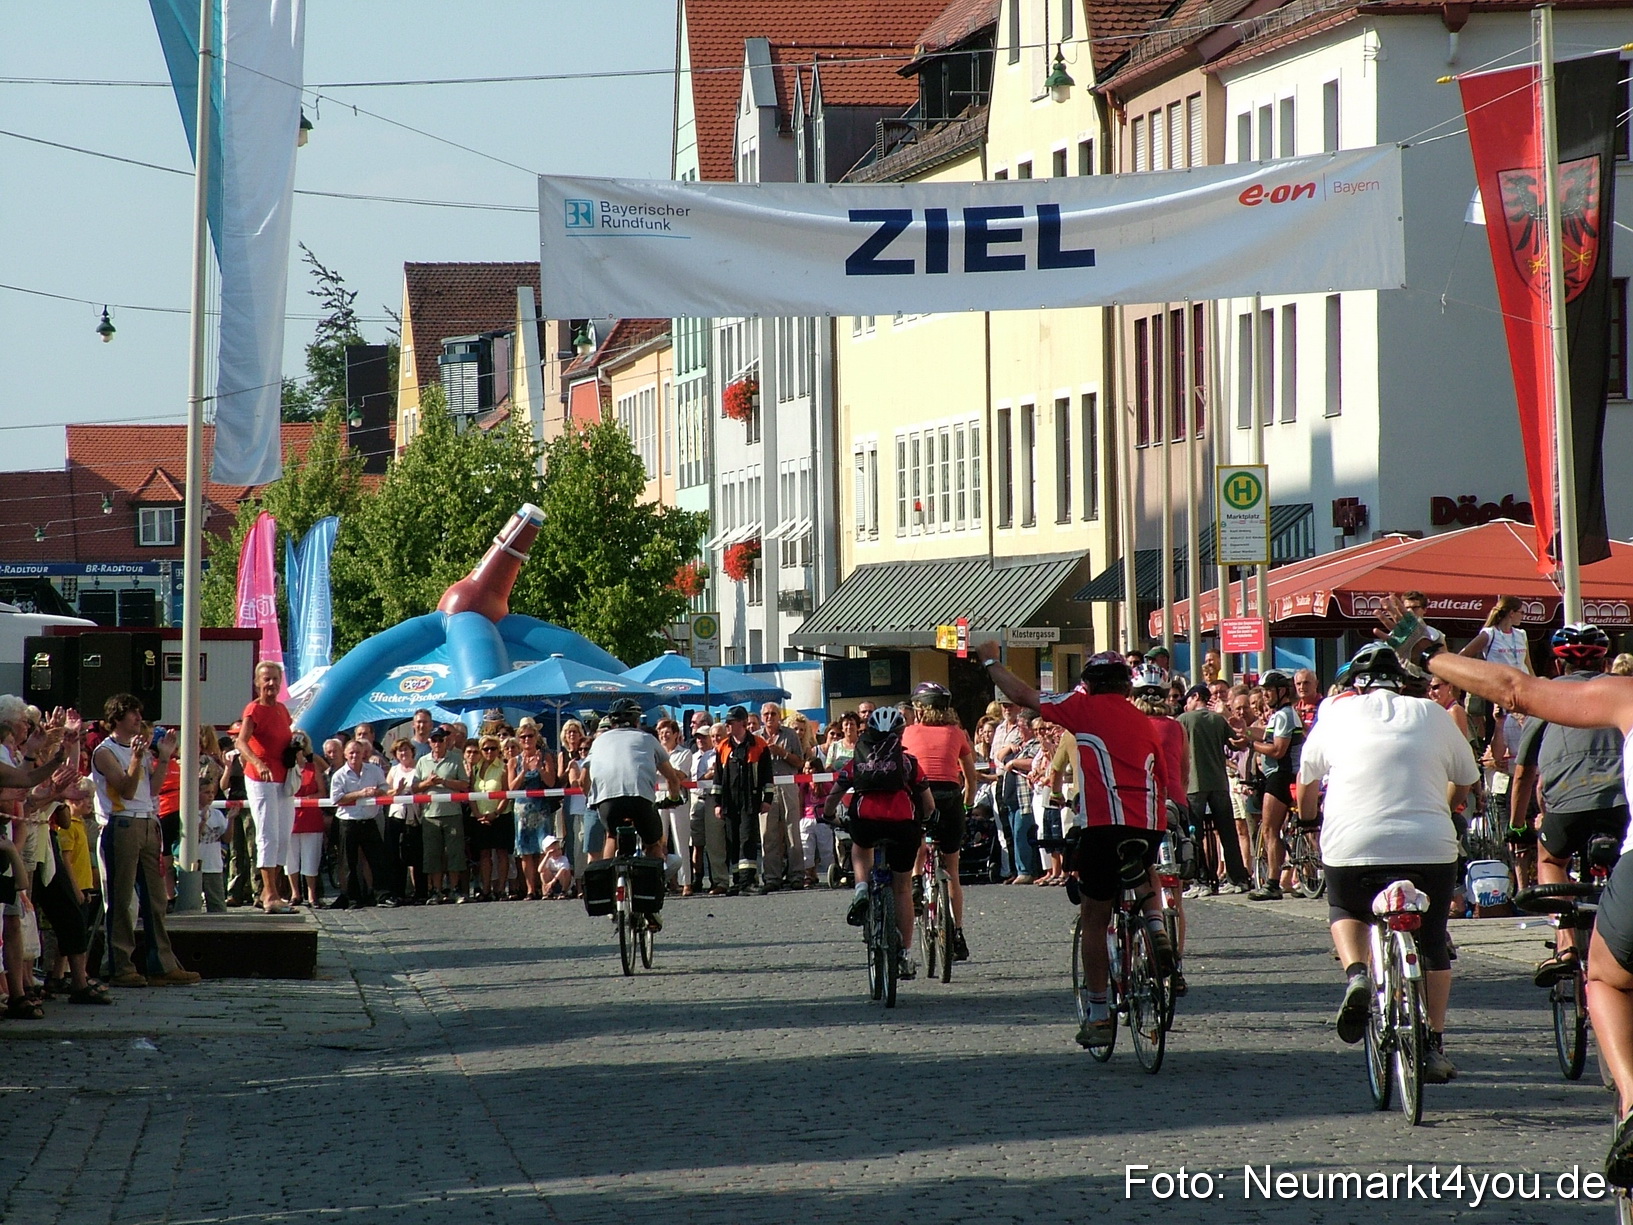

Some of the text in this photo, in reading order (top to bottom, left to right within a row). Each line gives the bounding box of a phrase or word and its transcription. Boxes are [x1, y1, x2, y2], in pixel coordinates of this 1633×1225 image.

[1333, 180, 1380, 196] Bayern
[600, 200, 691, 217] Bayerischer
[601, 214, 672, 231] Rundfunk
[845, 203, 1096, 276] ZIEL
[1233, 480, 1252, 501] H
[1431, 493, 1534, 525] Döpfe
[1426, 598, 1483, 611] tadtcafé
[1587, 616, 1632, 624] Stadtcafé
[1011, 630, 1056, 640] Klostergasse
[369, 691, 448, 705] Hacker-Pschorr
